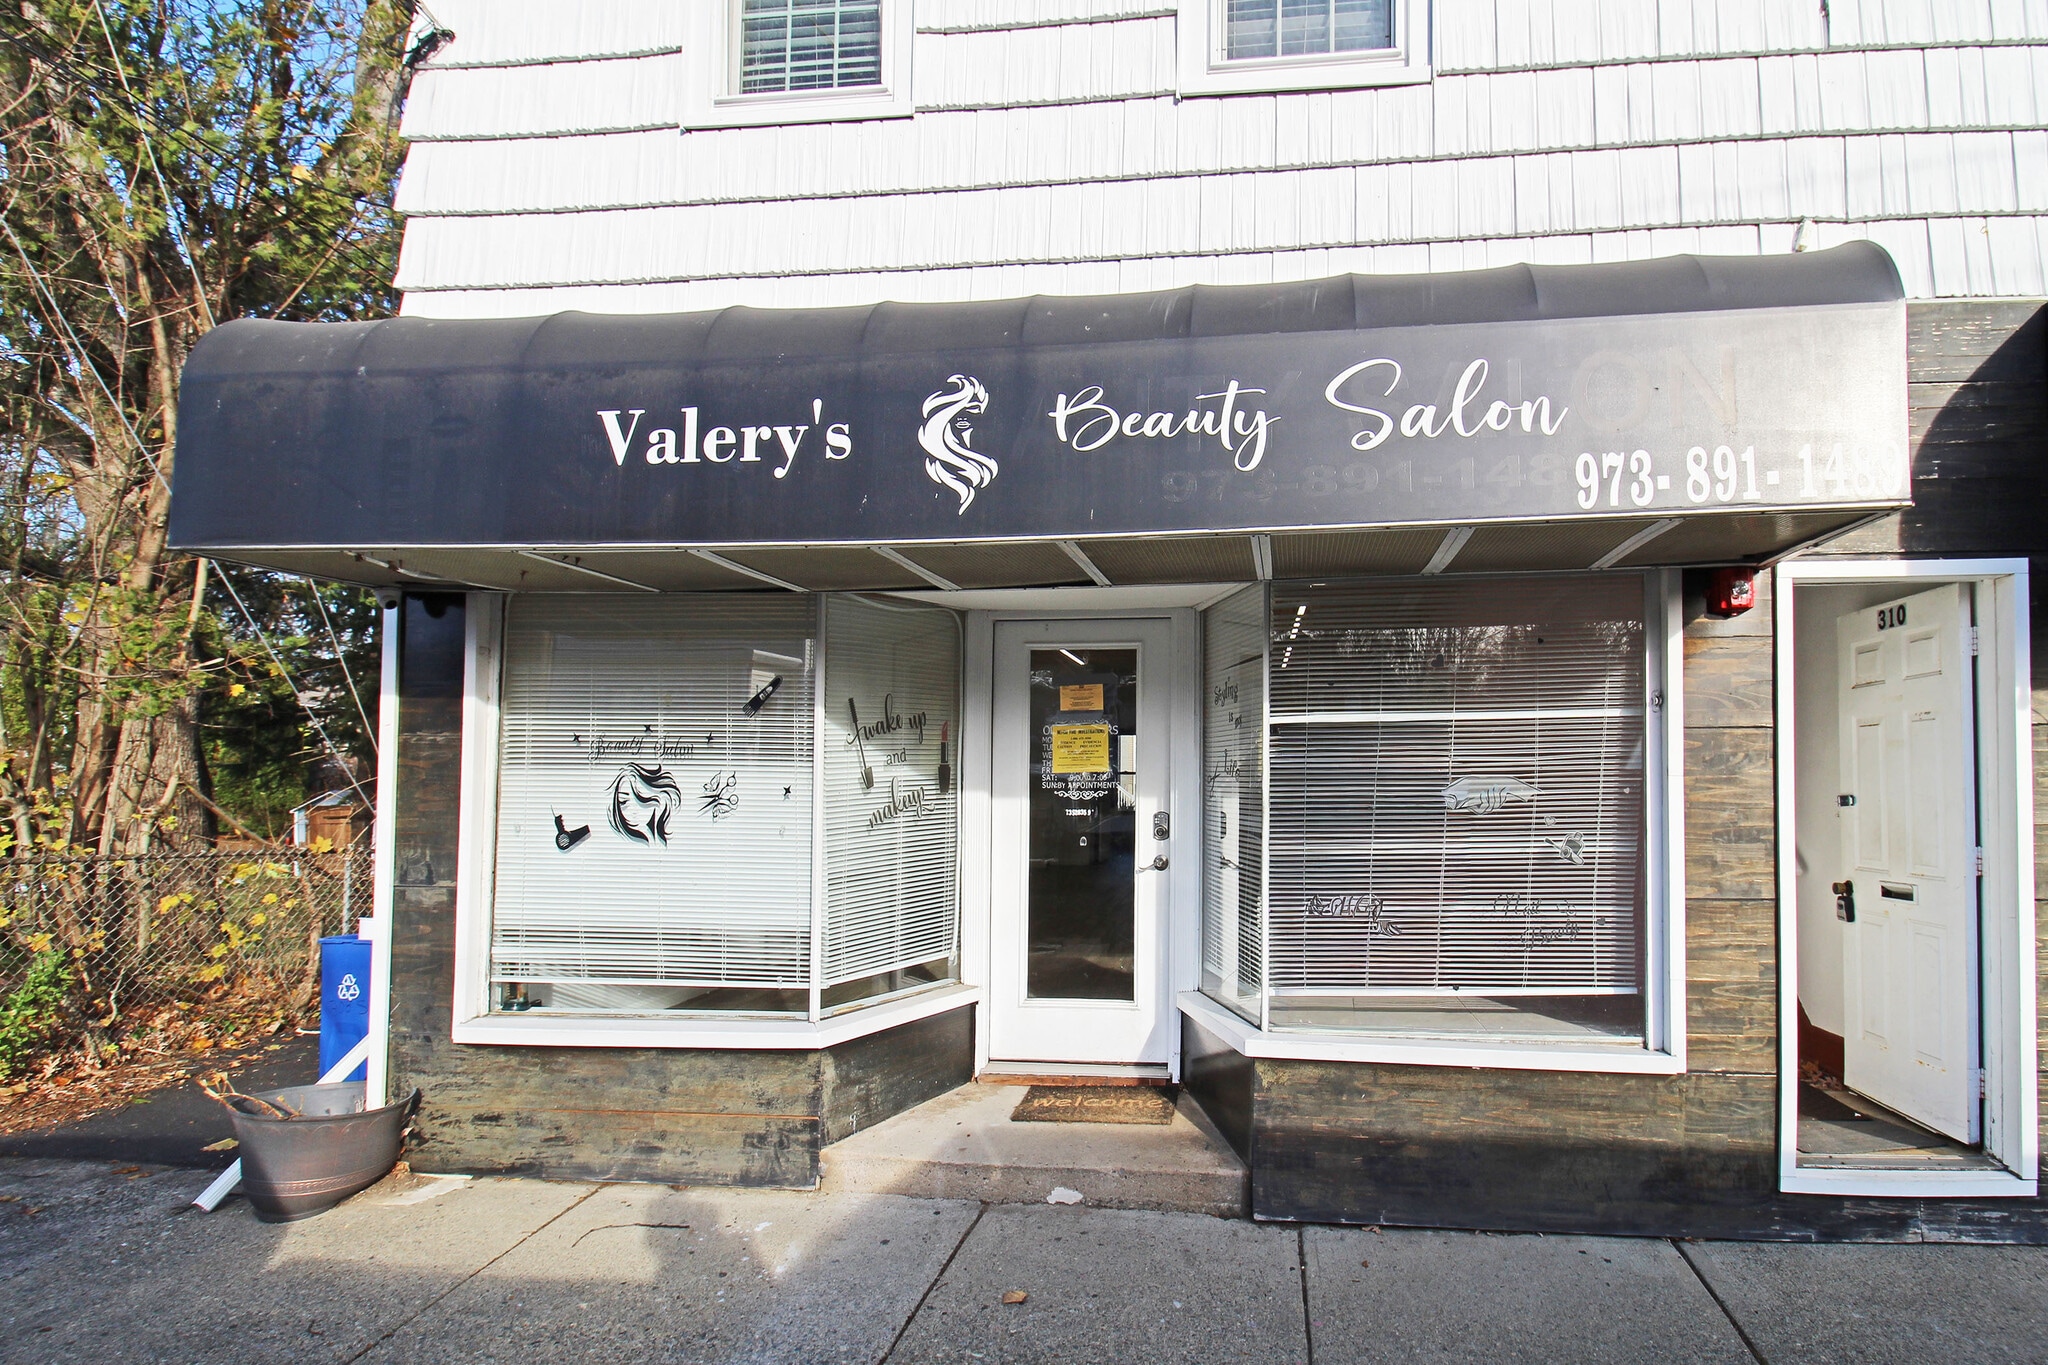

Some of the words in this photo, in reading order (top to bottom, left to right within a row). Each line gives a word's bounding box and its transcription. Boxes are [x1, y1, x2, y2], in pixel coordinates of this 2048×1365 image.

[597, 398, 852, 479] Valery's
[1048, 380, 1281, 471] Beauty
[1325, 358, 1568, 451] Salon
[1575, 449, 1671, 510] 973-
[1685, 445, 1780, 503] 891-
[1799, 440, 1902, 498] 1489
[1877, 603, 1906, 631] 310
[908, 711, 927, 745] up
[588, 732, 645, 761] Beauty
[886, 748, 907, 766] and
[868, 776, 936, 829] makeup
[1032, 1095, 1163, 1109] welcome
